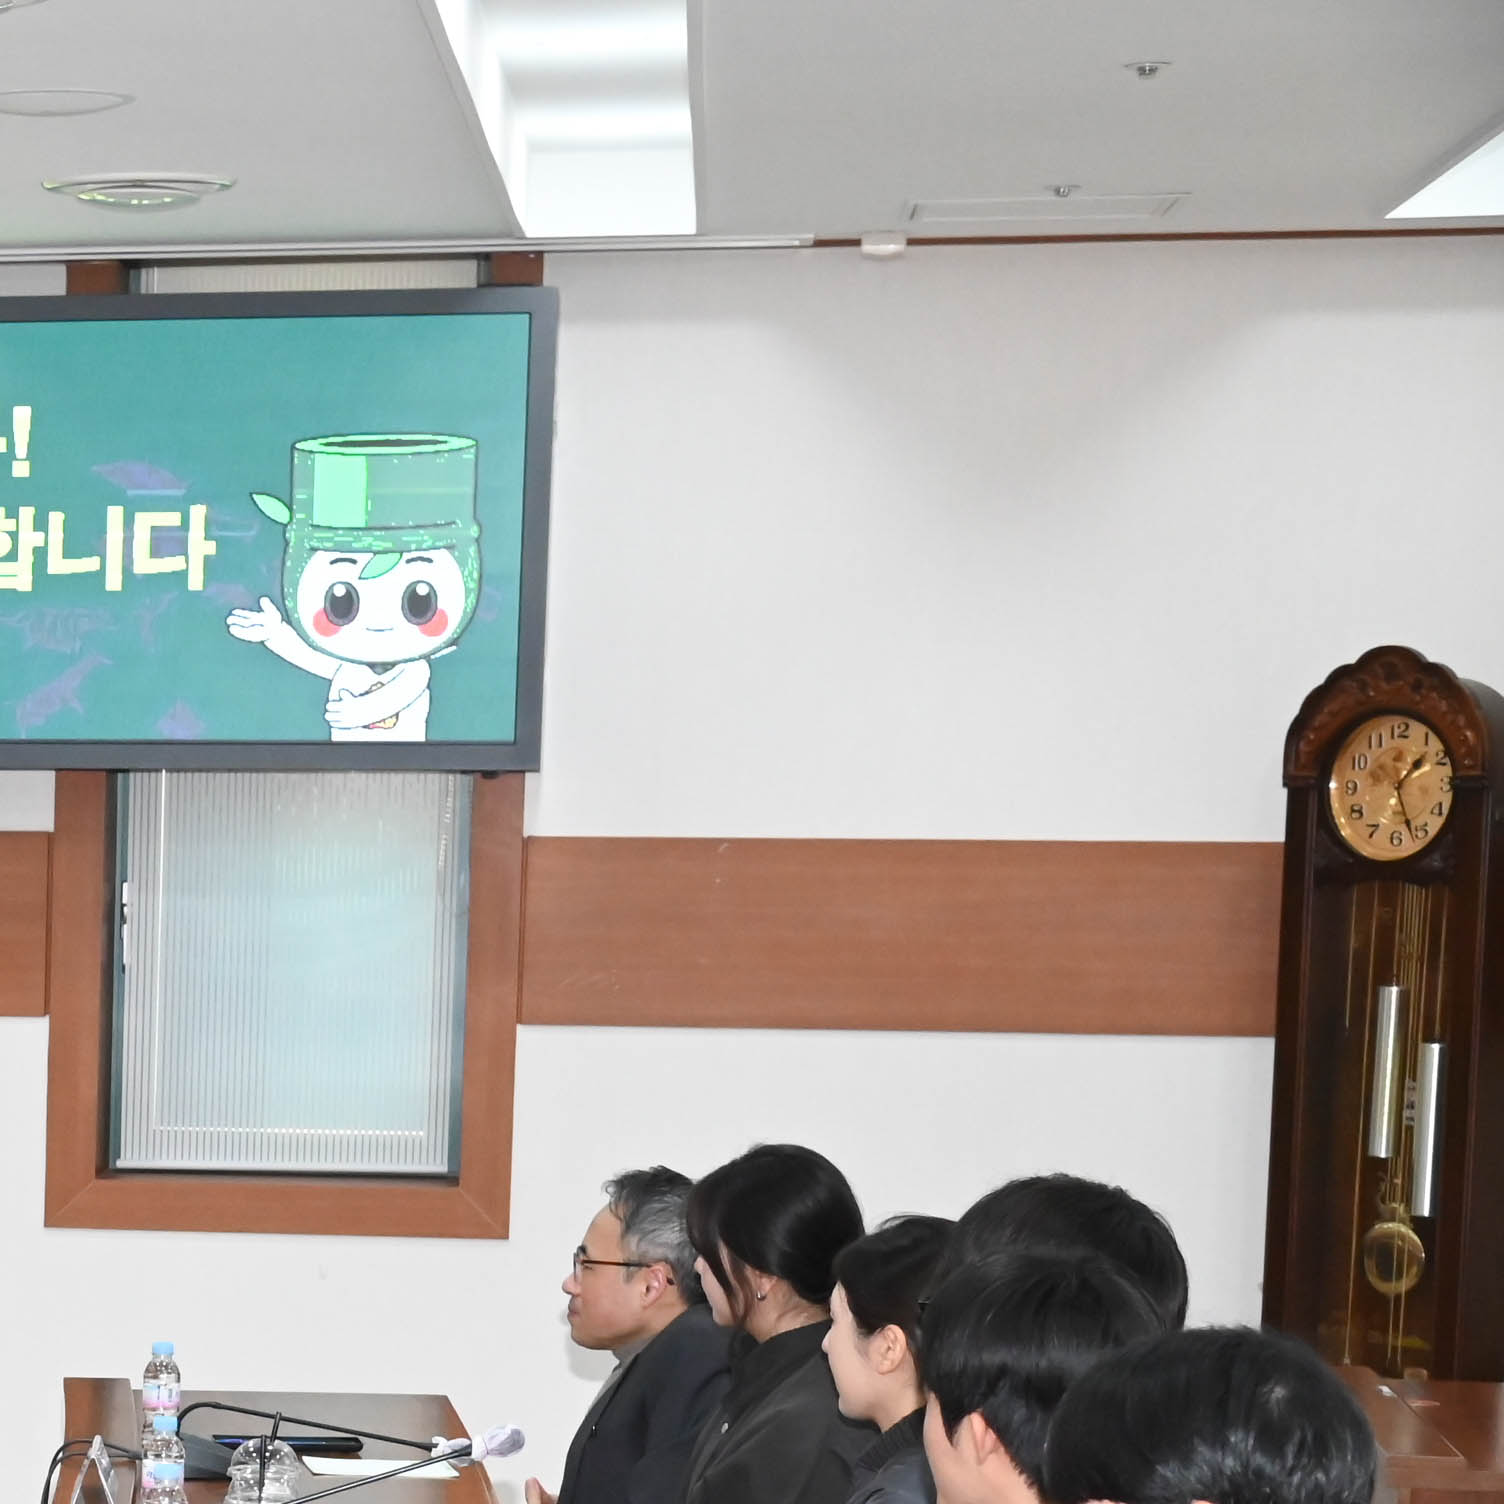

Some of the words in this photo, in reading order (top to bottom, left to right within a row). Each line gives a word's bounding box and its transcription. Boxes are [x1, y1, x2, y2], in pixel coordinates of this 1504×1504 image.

[1391, 722, 1410, 739] 12
[1368, 732, 1383, 749] 11
[1352, 753, 1368, 770] 10
[1435, 751, 1447, 766] 2
[1345, 780, 1357, 796] 9
[1350, 804, 1364, 820] 8
[1430, 802, 1443, 817] 4
[1366, 823, 1379, 839] 7
[1390, 831, 1403, 847] 6
[1415, 823, 1429, 840] 5
